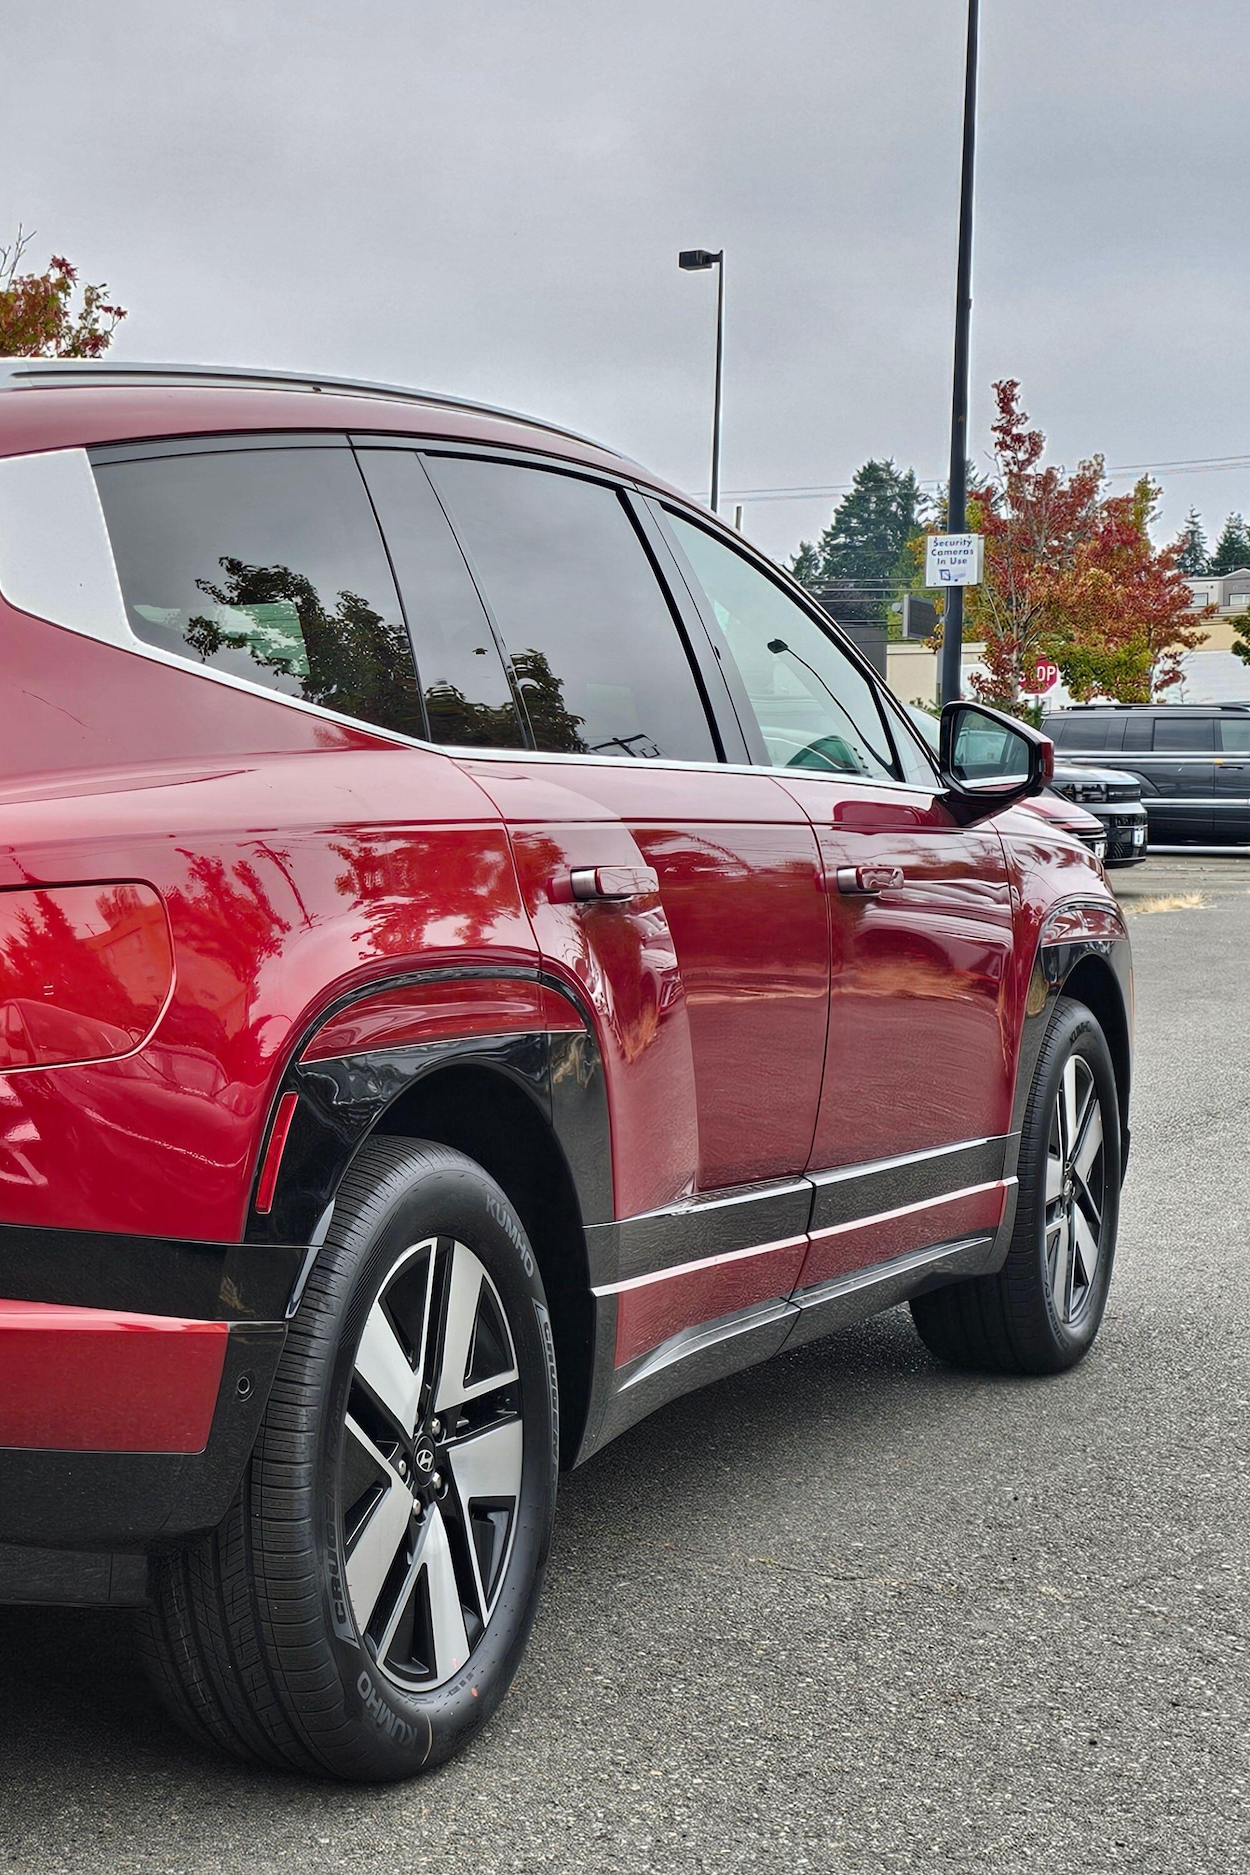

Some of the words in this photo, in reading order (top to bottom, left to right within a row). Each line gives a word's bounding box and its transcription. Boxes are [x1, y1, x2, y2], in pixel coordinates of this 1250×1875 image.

[933, 538, 972, 547] Security
[950, 557, 967, 565] Use
[1019, 665, 1056, 682] OP
[486, 1193, 534, 1278] KUMHO
[357, 1670, 418, 1746] KUMHO
